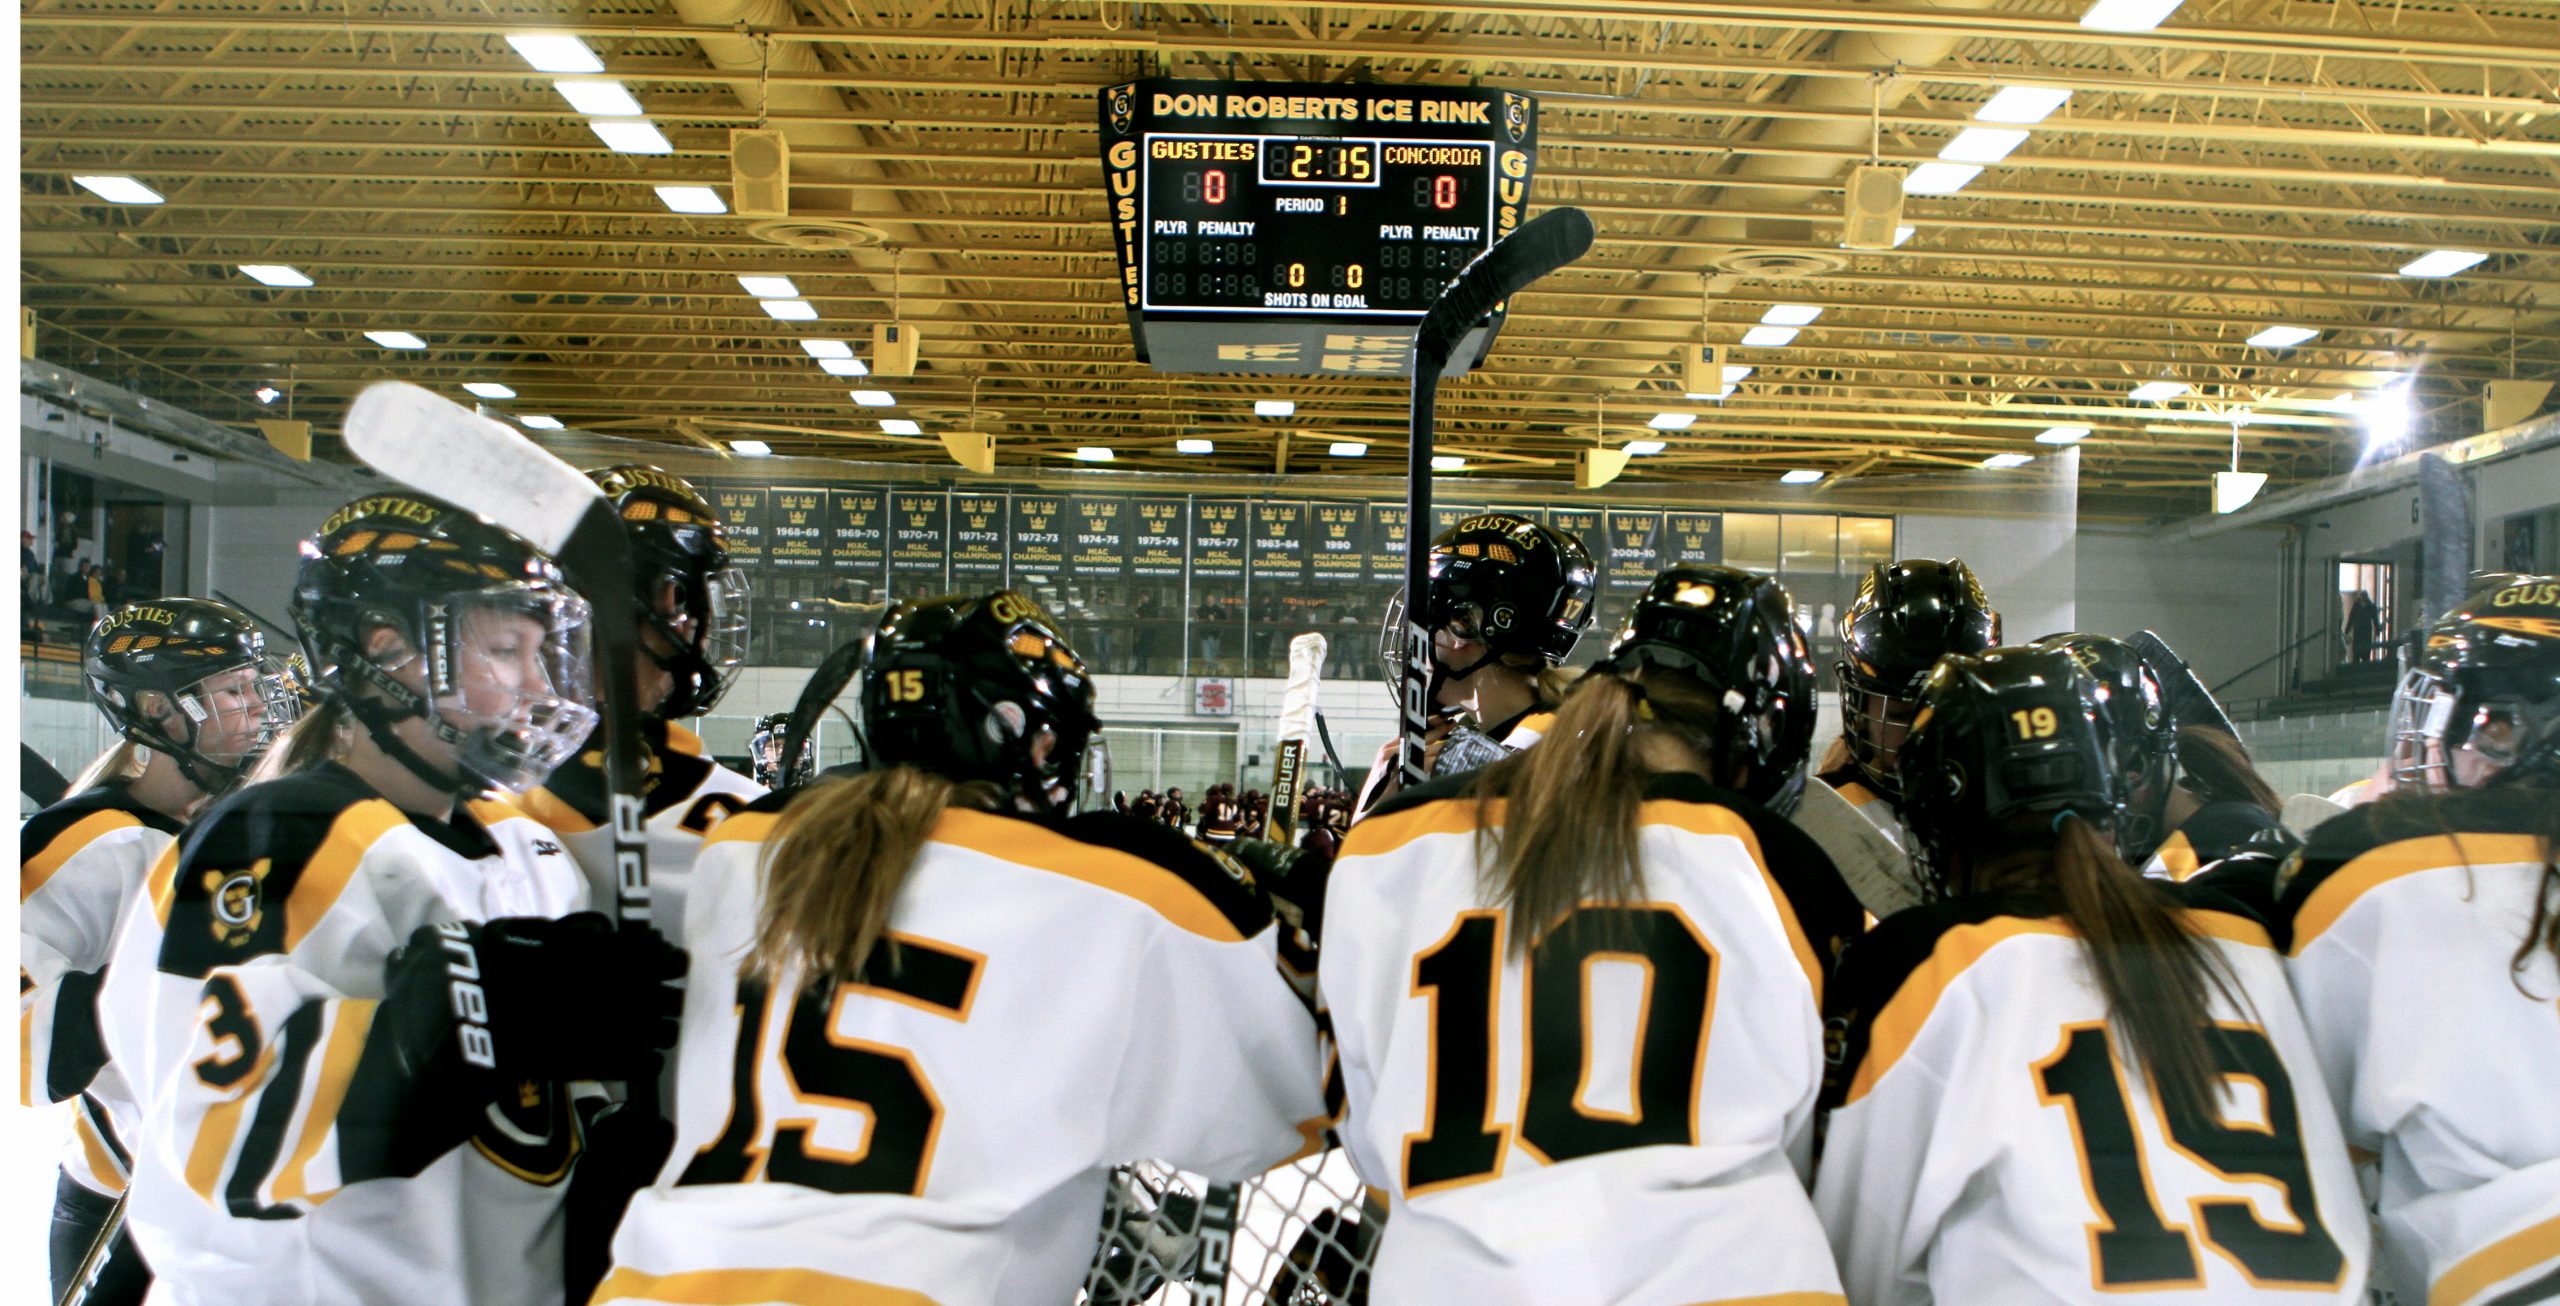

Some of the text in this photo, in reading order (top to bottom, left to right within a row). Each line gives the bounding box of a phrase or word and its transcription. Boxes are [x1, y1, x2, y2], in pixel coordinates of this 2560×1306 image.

[1153, 94, 1491, 124] DON ROBERTS ICE RINK
[1152, 141, 1255, 161] GUSTIES
[1385, 147, 1482, 165] CONCORDIA
[1291, 145, 1370, 179] 2:15
[1204, 169, 1226, 204] 0
[1435, 175, 1457, 209] 0
[1275, 198, 1325, 213] PERIOD
[1340, 196, 1347, 215] 1
[1108, 141, 1139, 305] GUSTIES
[1154, 220, 1256, 236] PLYR PENALTY
[1380, 225, 1480, 241] PLYR PENALTY
[1289, 263, 1304, 287] 0
[1347, 264, 1362, 288] 0
[1264, 293, 1369, 309] SHOTS ON GOAL
[602, 469, 693, 499] GUSTIES
[322, 497, 441, 536] GUSTIES
[723, 526, 759, 536] 67-68
[776, 527, 819, 537] 1968-69
[836, 529, 880, 538] 1969-70
[898, 530, 939, 539] 1970-71
[958, 531, 998, 541] 1971-72
[1018, 533, 1059, 542] 1972-73
[1078, 534, 1119, 544] 1974-75
[1460, 516, 1541, 550] GUSTIES
[1138, 536, 1179, 545] 1975-76
[1197, 538, 1238, 547] 1976-77
[1325, 540, 1350, 550] 1990
[772, 548, 822, 556] CHAMPIONS
[833, 549, 882, 558] CHAMPIONS
[892, 550, 942, 559] CHAMPIONS
[953, 551, 1002, 560] CHAMPIONS
[1013, 553, 1062, 561] CHAMPIONS
[1073, 555, 1122, 563] CHAMPIONS
[1611, 548, 1656, 558] 2009-10
[1681, 550, 1705, 560] 2012
[1133, 556, 1182, 565] CHAMPIONS
[1193, 557, 1242, 566] CHAMPIONS
[1253, 559, 1302, 568] CHAMPIONS
[1313, 560, 1361, 568] CHAMPIONS
[1563, 598, 1584, 620] 17
[100, 606, 177, 637] GUSTIES
[887, 670, 924, 702] 15
[2011, 707, 2057, 740] 19
[1276, 745, 1298, 807] BAUER
[216, 875, 256, 923] G
[191, 970, 267, 1092] 3
[1401, 899, 1721, 1200] 10
[673, 930, 989, 1199] 15
[2028, 1018, 2349, 1294] 19
